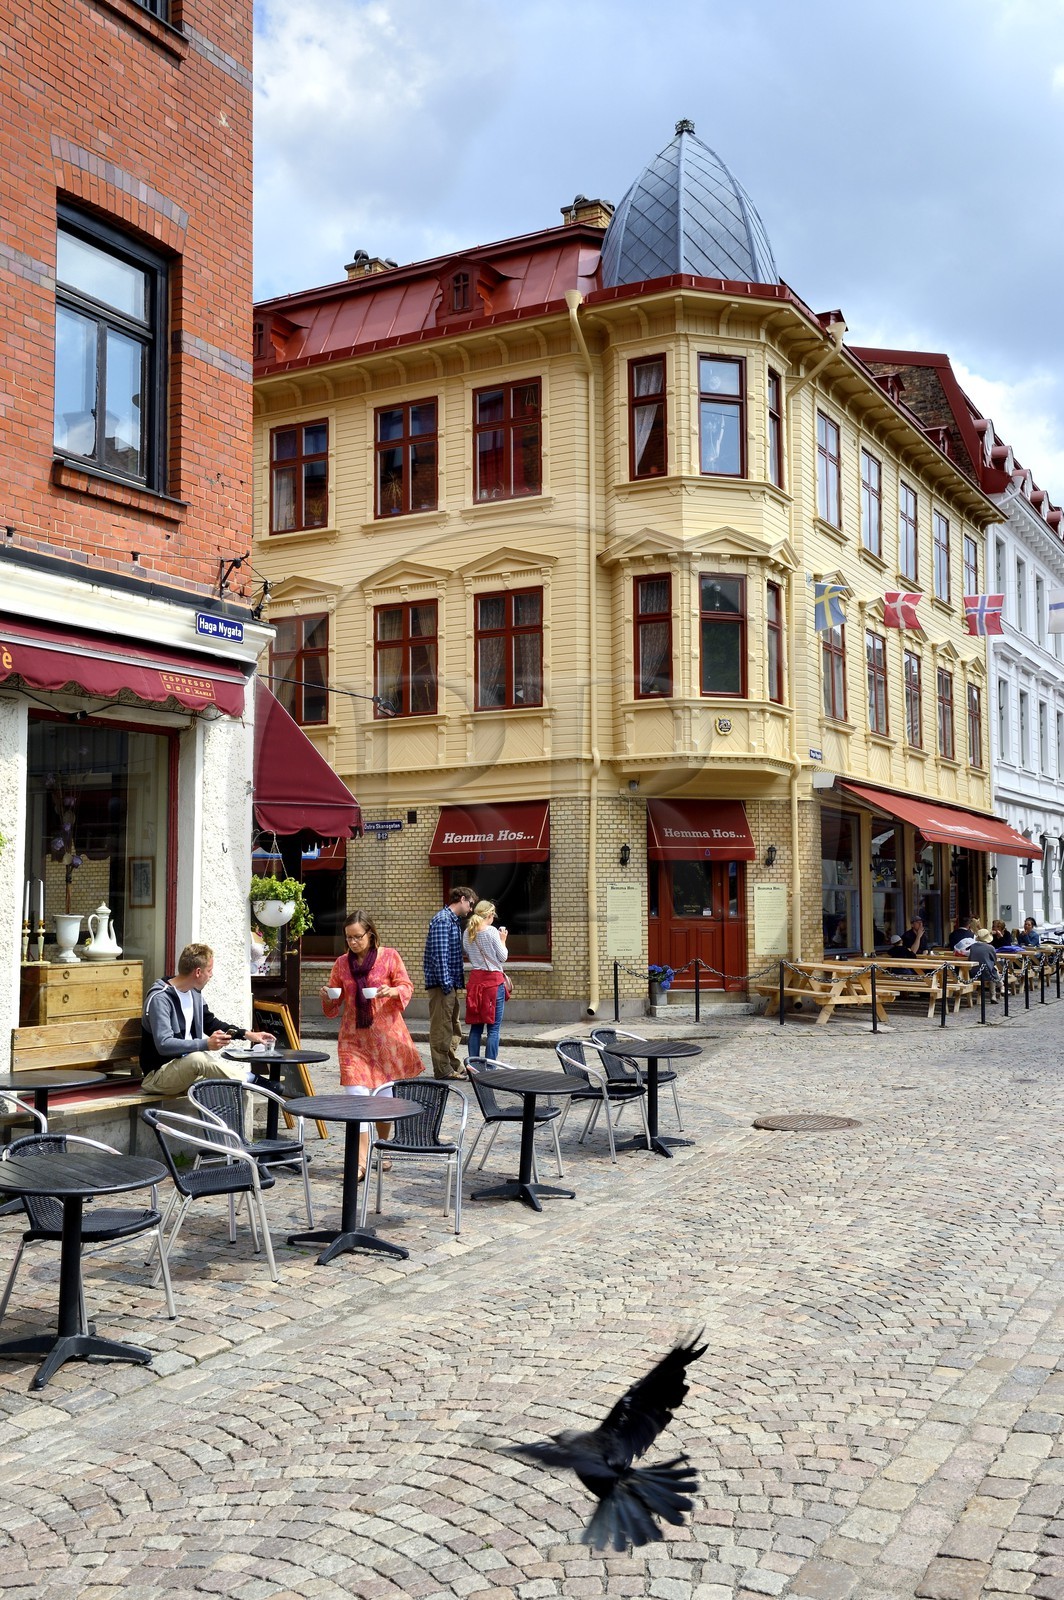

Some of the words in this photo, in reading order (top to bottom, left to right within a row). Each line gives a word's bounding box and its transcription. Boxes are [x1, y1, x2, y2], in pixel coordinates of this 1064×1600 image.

[199, 617, 217, 633] Haga
[218, 621, 242, 637] Nygata
[0, 646, 12, 669] è
[162, 674, 211, 689] ESPRESSO
[442, 832, 494, 844] Hemma
[496, 829, 535, 842] Hos...
[663, 828, 710, 838] Hemma
[711, 828, 746, 838] Hos...
